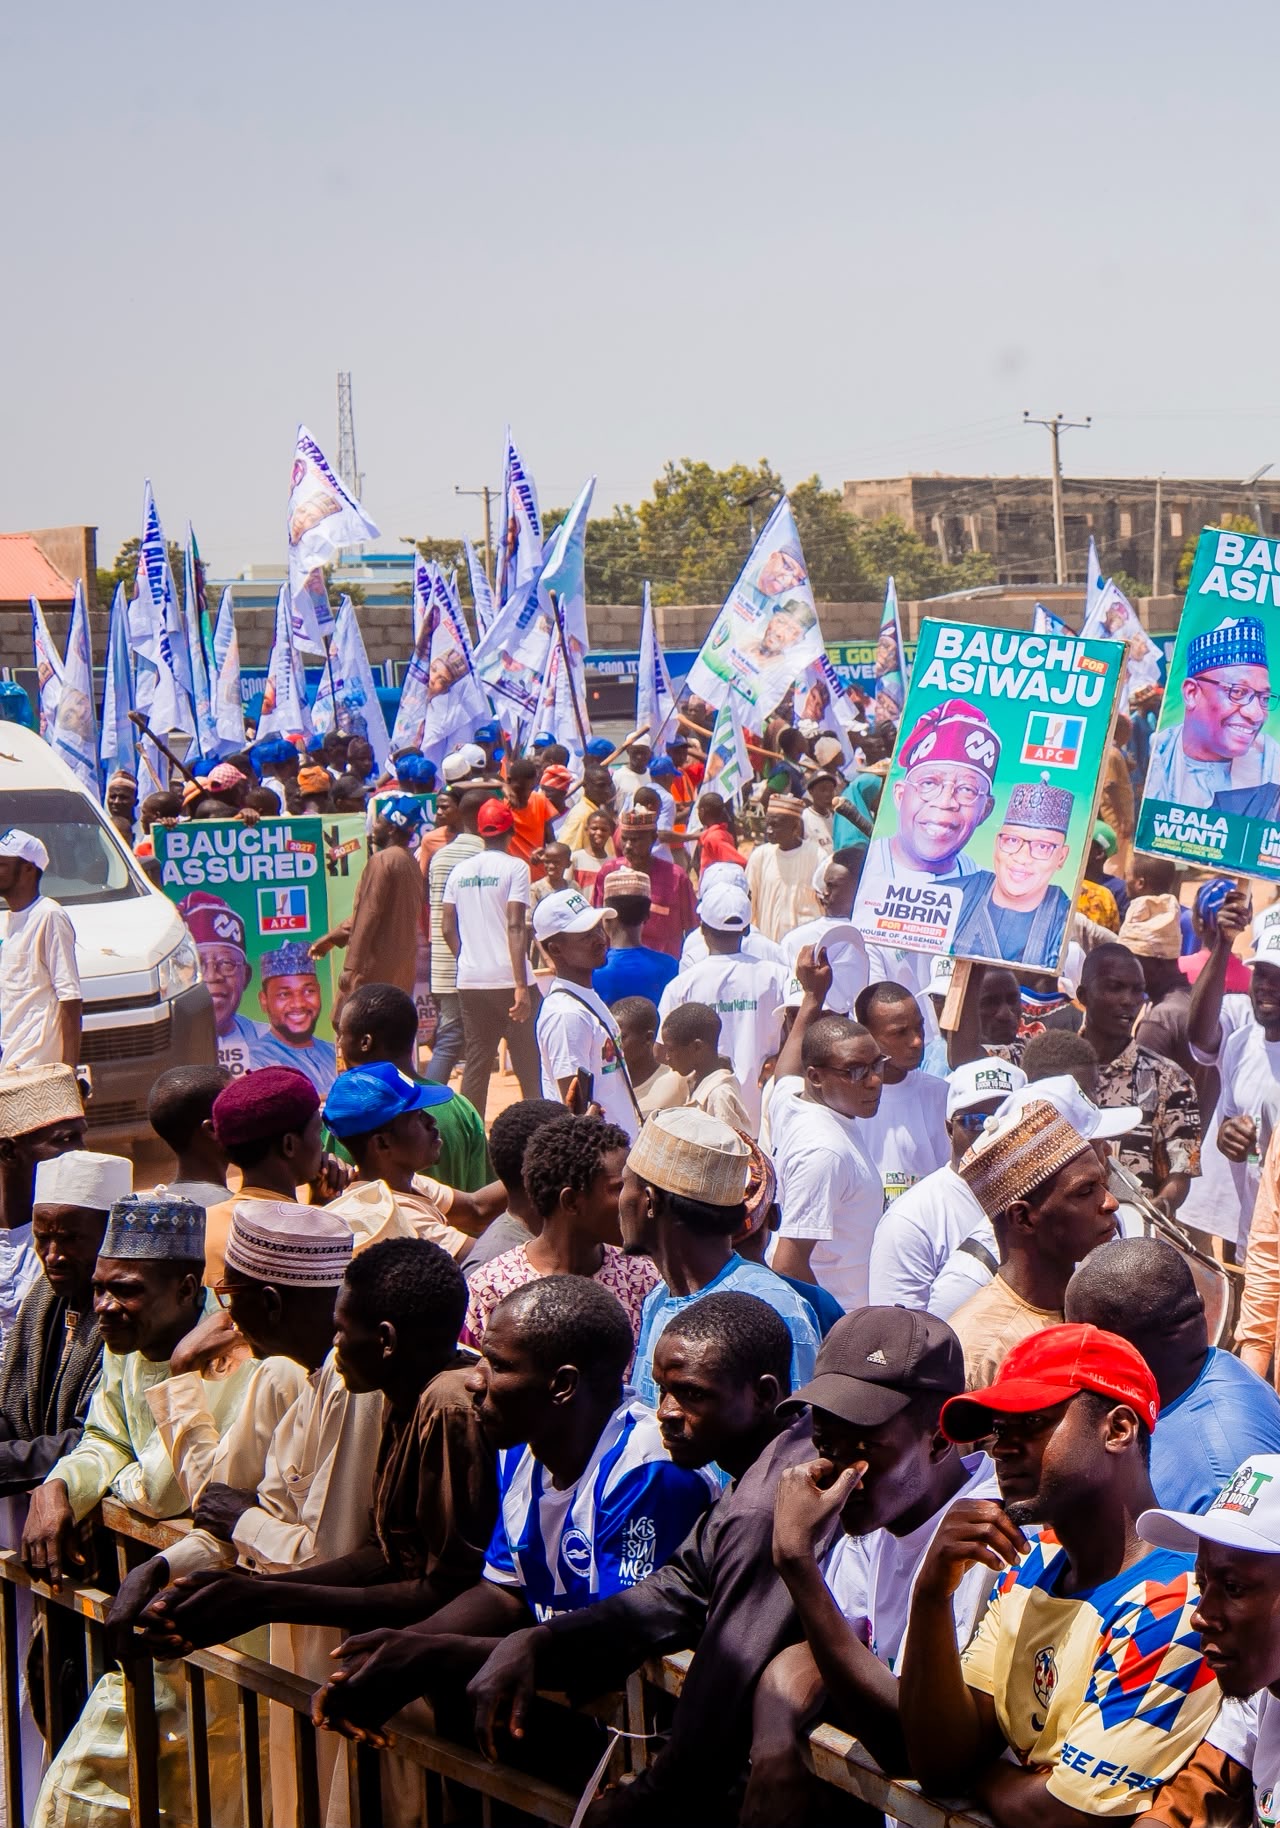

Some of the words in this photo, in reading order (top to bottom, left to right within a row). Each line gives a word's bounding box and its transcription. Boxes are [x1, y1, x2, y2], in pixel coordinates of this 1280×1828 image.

[935, 628, 1085, 672] BAUCHI
[1081, 659, 1105, 673] FOR
[918, 660, 1105, 708] ASIWAJU
[1034, 749, 1064, 762] APC
[1155, 814, 1167, 822] DR
[1169, 808, 1229, 833] BALA
[166, 826, 292, 858] BAUCHI
[290, 842, 312, 852] 2027
[1153, 821, 1228, 849] WUNTI
[162, 853, 317, 886] ASSURED
[886, 885, 952, 909] MUSA
[270, 918, 296, 928] APC
[874, 902, 951, 926] JIBRIN
[881, 920, 901, 930] FOR
[860, 928, 886, 937] HOUSE
[903, 933, 944, 945] ASSEMBLY
[1228, 1493, 1255, 1508] DOOR
